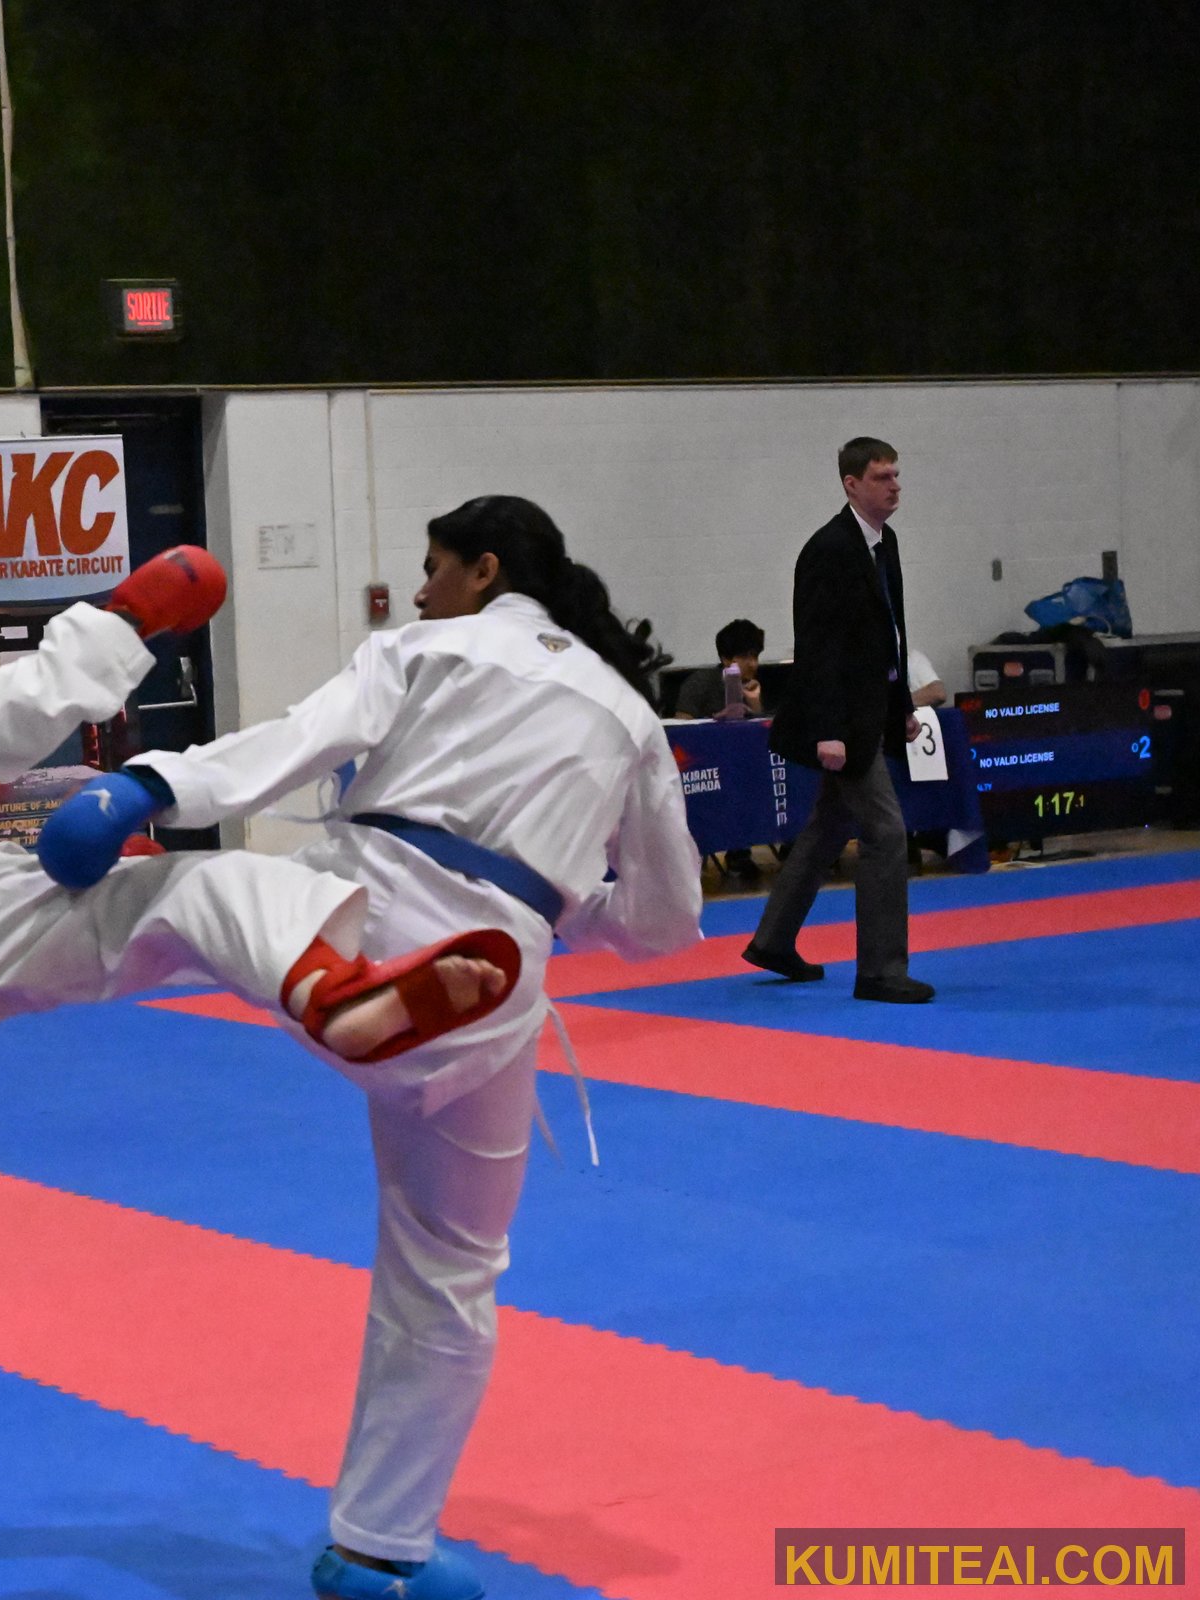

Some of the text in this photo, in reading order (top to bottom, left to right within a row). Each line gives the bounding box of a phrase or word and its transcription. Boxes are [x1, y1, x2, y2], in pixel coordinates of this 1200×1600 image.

[127, 291, 170, 321] SORTIE
[11, 558, 64, 578] KARATE
[66, 555, 124, 577] CIRCUIT
[985, 702, 1060, 719] NO VALID LICENSE
[921, 722, 937, 756] 3
[979, 751, 1055, 769] NO VALID LICENSE
[682, 767, 720, 783] KARATE
[683, 779, 721, 795] CANADA
[30, 801, 42, 811] OF
